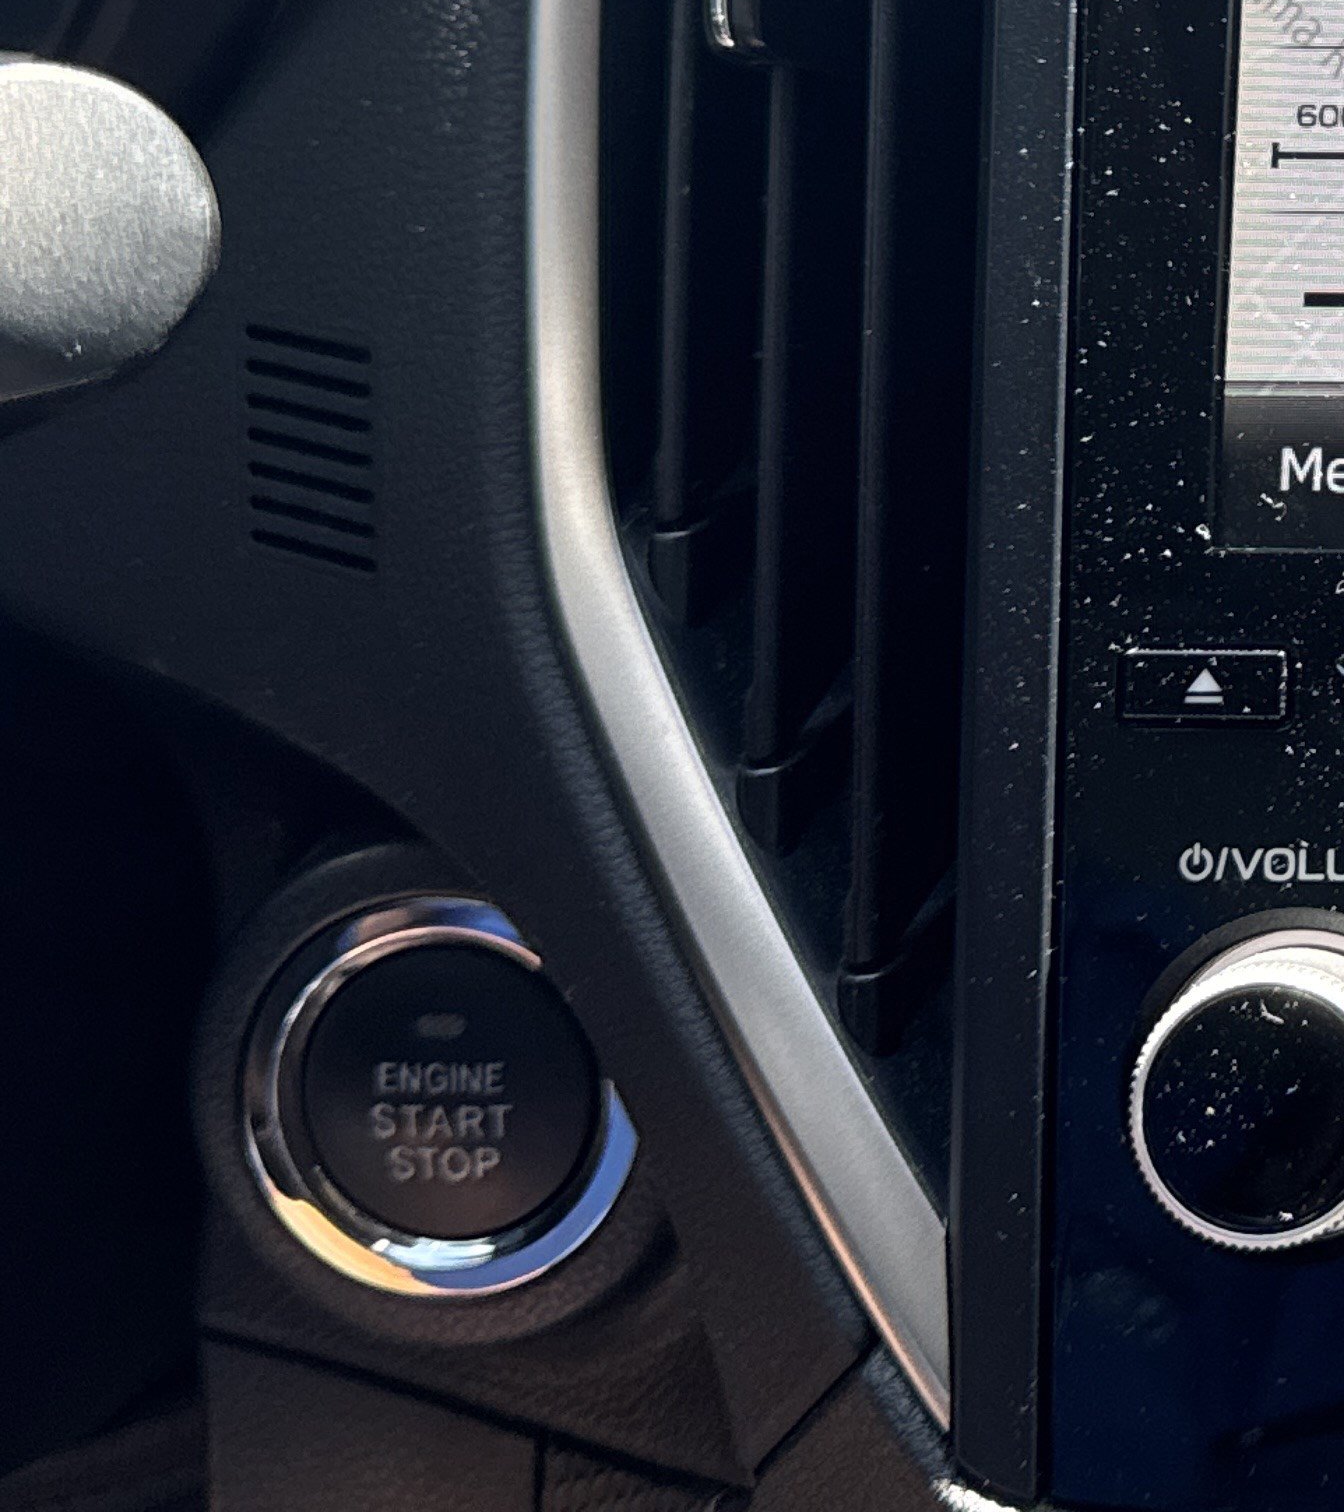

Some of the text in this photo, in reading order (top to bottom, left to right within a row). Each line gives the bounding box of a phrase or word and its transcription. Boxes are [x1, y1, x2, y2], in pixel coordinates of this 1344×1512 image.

[374, 1061, 506, 1095] ENGINE
[369, 1102, 514, 1141] START
[386, 1144, 502, 1183] STOP
